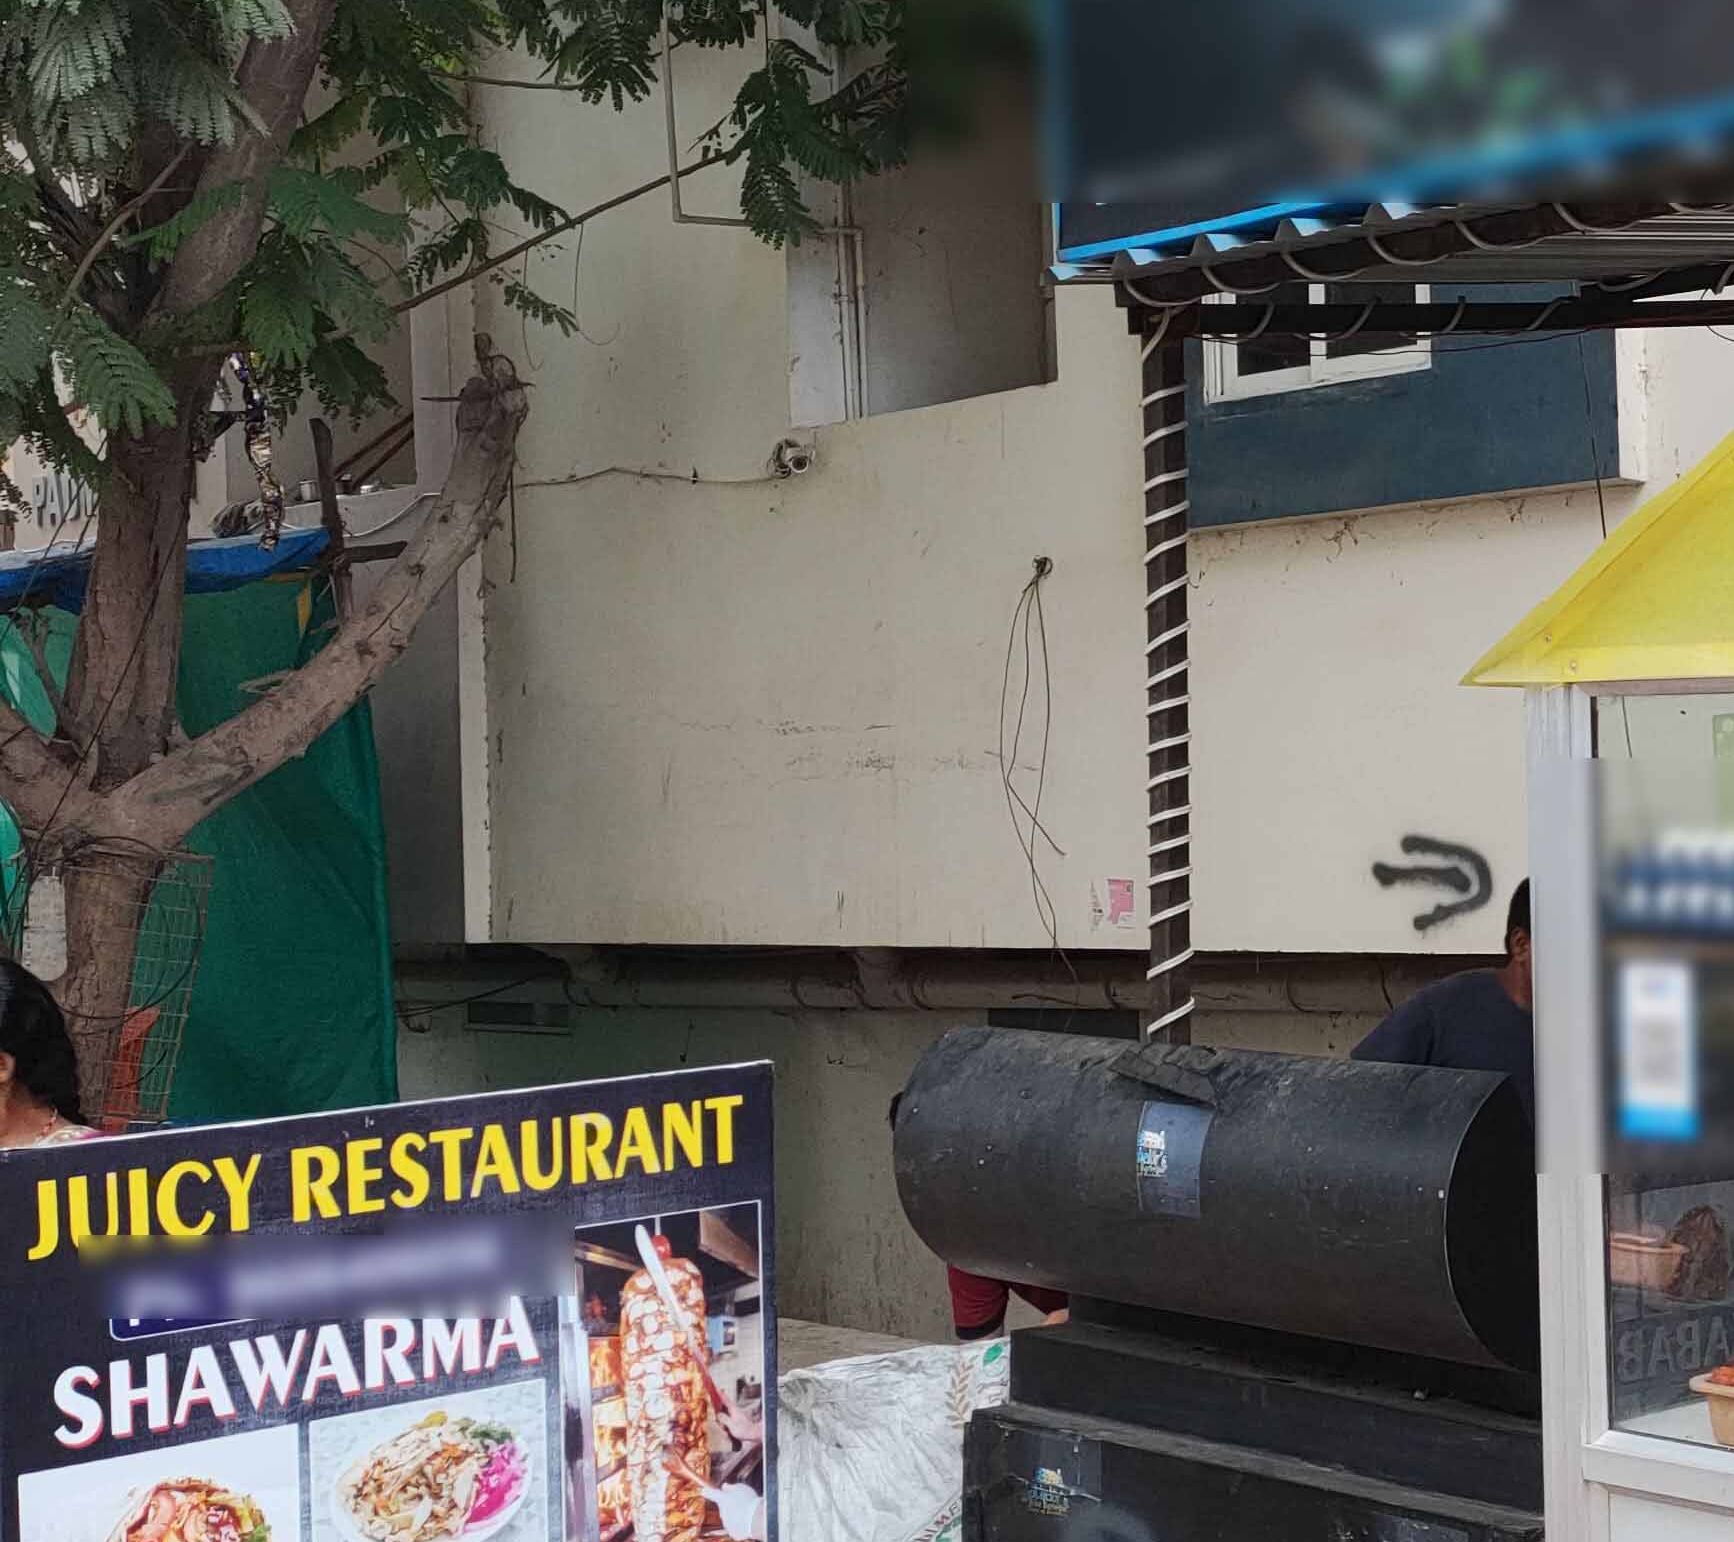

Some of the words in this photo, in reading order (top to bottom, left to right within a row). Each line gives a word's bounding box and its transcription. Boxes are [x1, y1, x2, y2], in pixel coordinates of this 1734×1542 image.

[28, 1153, 262, 1261] JUICY
[291, 1094, 744, 1222] RESTAURANT
[52, 1296, 542, 1449] SHAWARMA
